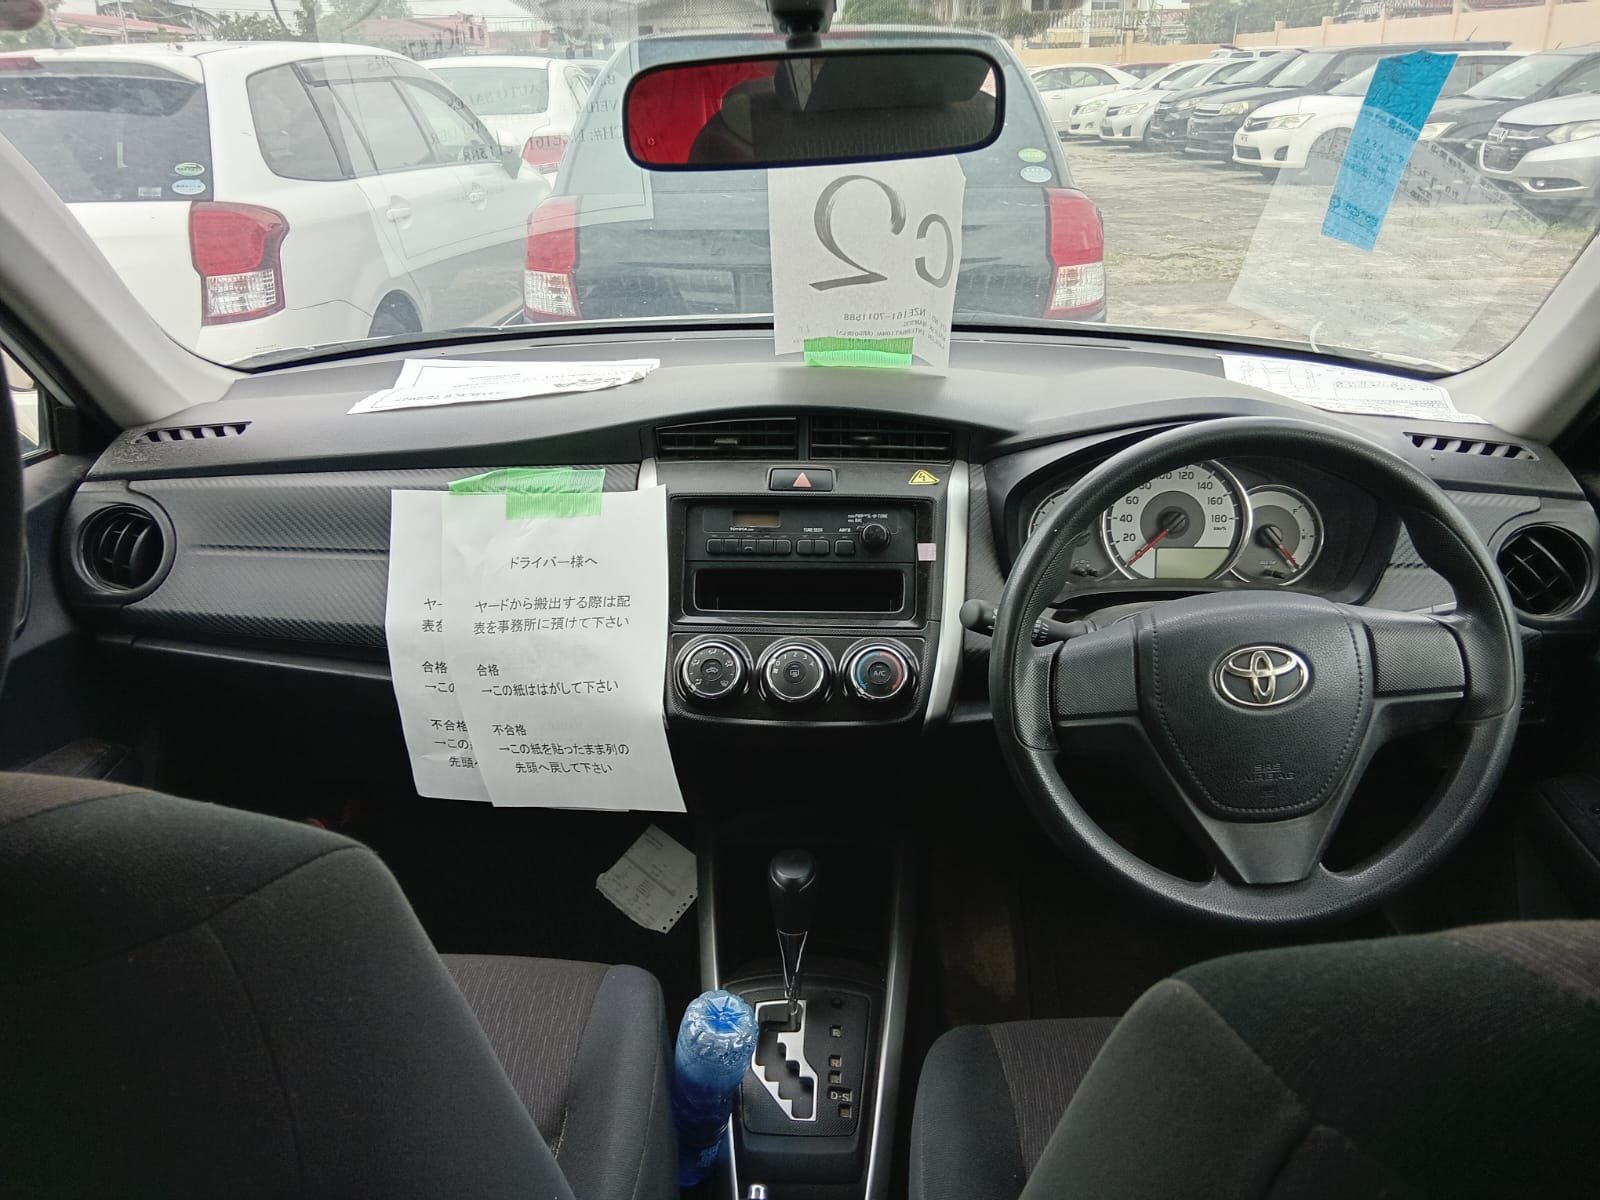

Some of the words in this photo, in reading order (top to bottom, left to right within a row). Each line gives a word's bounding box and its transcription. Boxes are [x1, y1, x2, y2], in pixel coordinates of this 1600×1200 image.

[1178, 471, 1194, 480] 120
[1197, 481, 1213, 490] 140
[1125, 496, 1139, 505] 60
[1207, 496, 1223, 505] 160
[1120, 514, 1133, 523] 40
[1211, 514, 1228, 523] 180
[1122, 533, 1136, 542] 20
[509, 554, 599, 569] ドライバー様へ
[474, 594, 631, 613] ヤードから搬出する際は配
[473, 616, 630, 636] 表を事務所に預けて下さい
[421, 660, 448, 674] 合格
[476, 663, 500, 677] 合格
[491, 723, 528, 736] 不合格
[515, 761, 613, 774] 先頭へ戻して下さい
